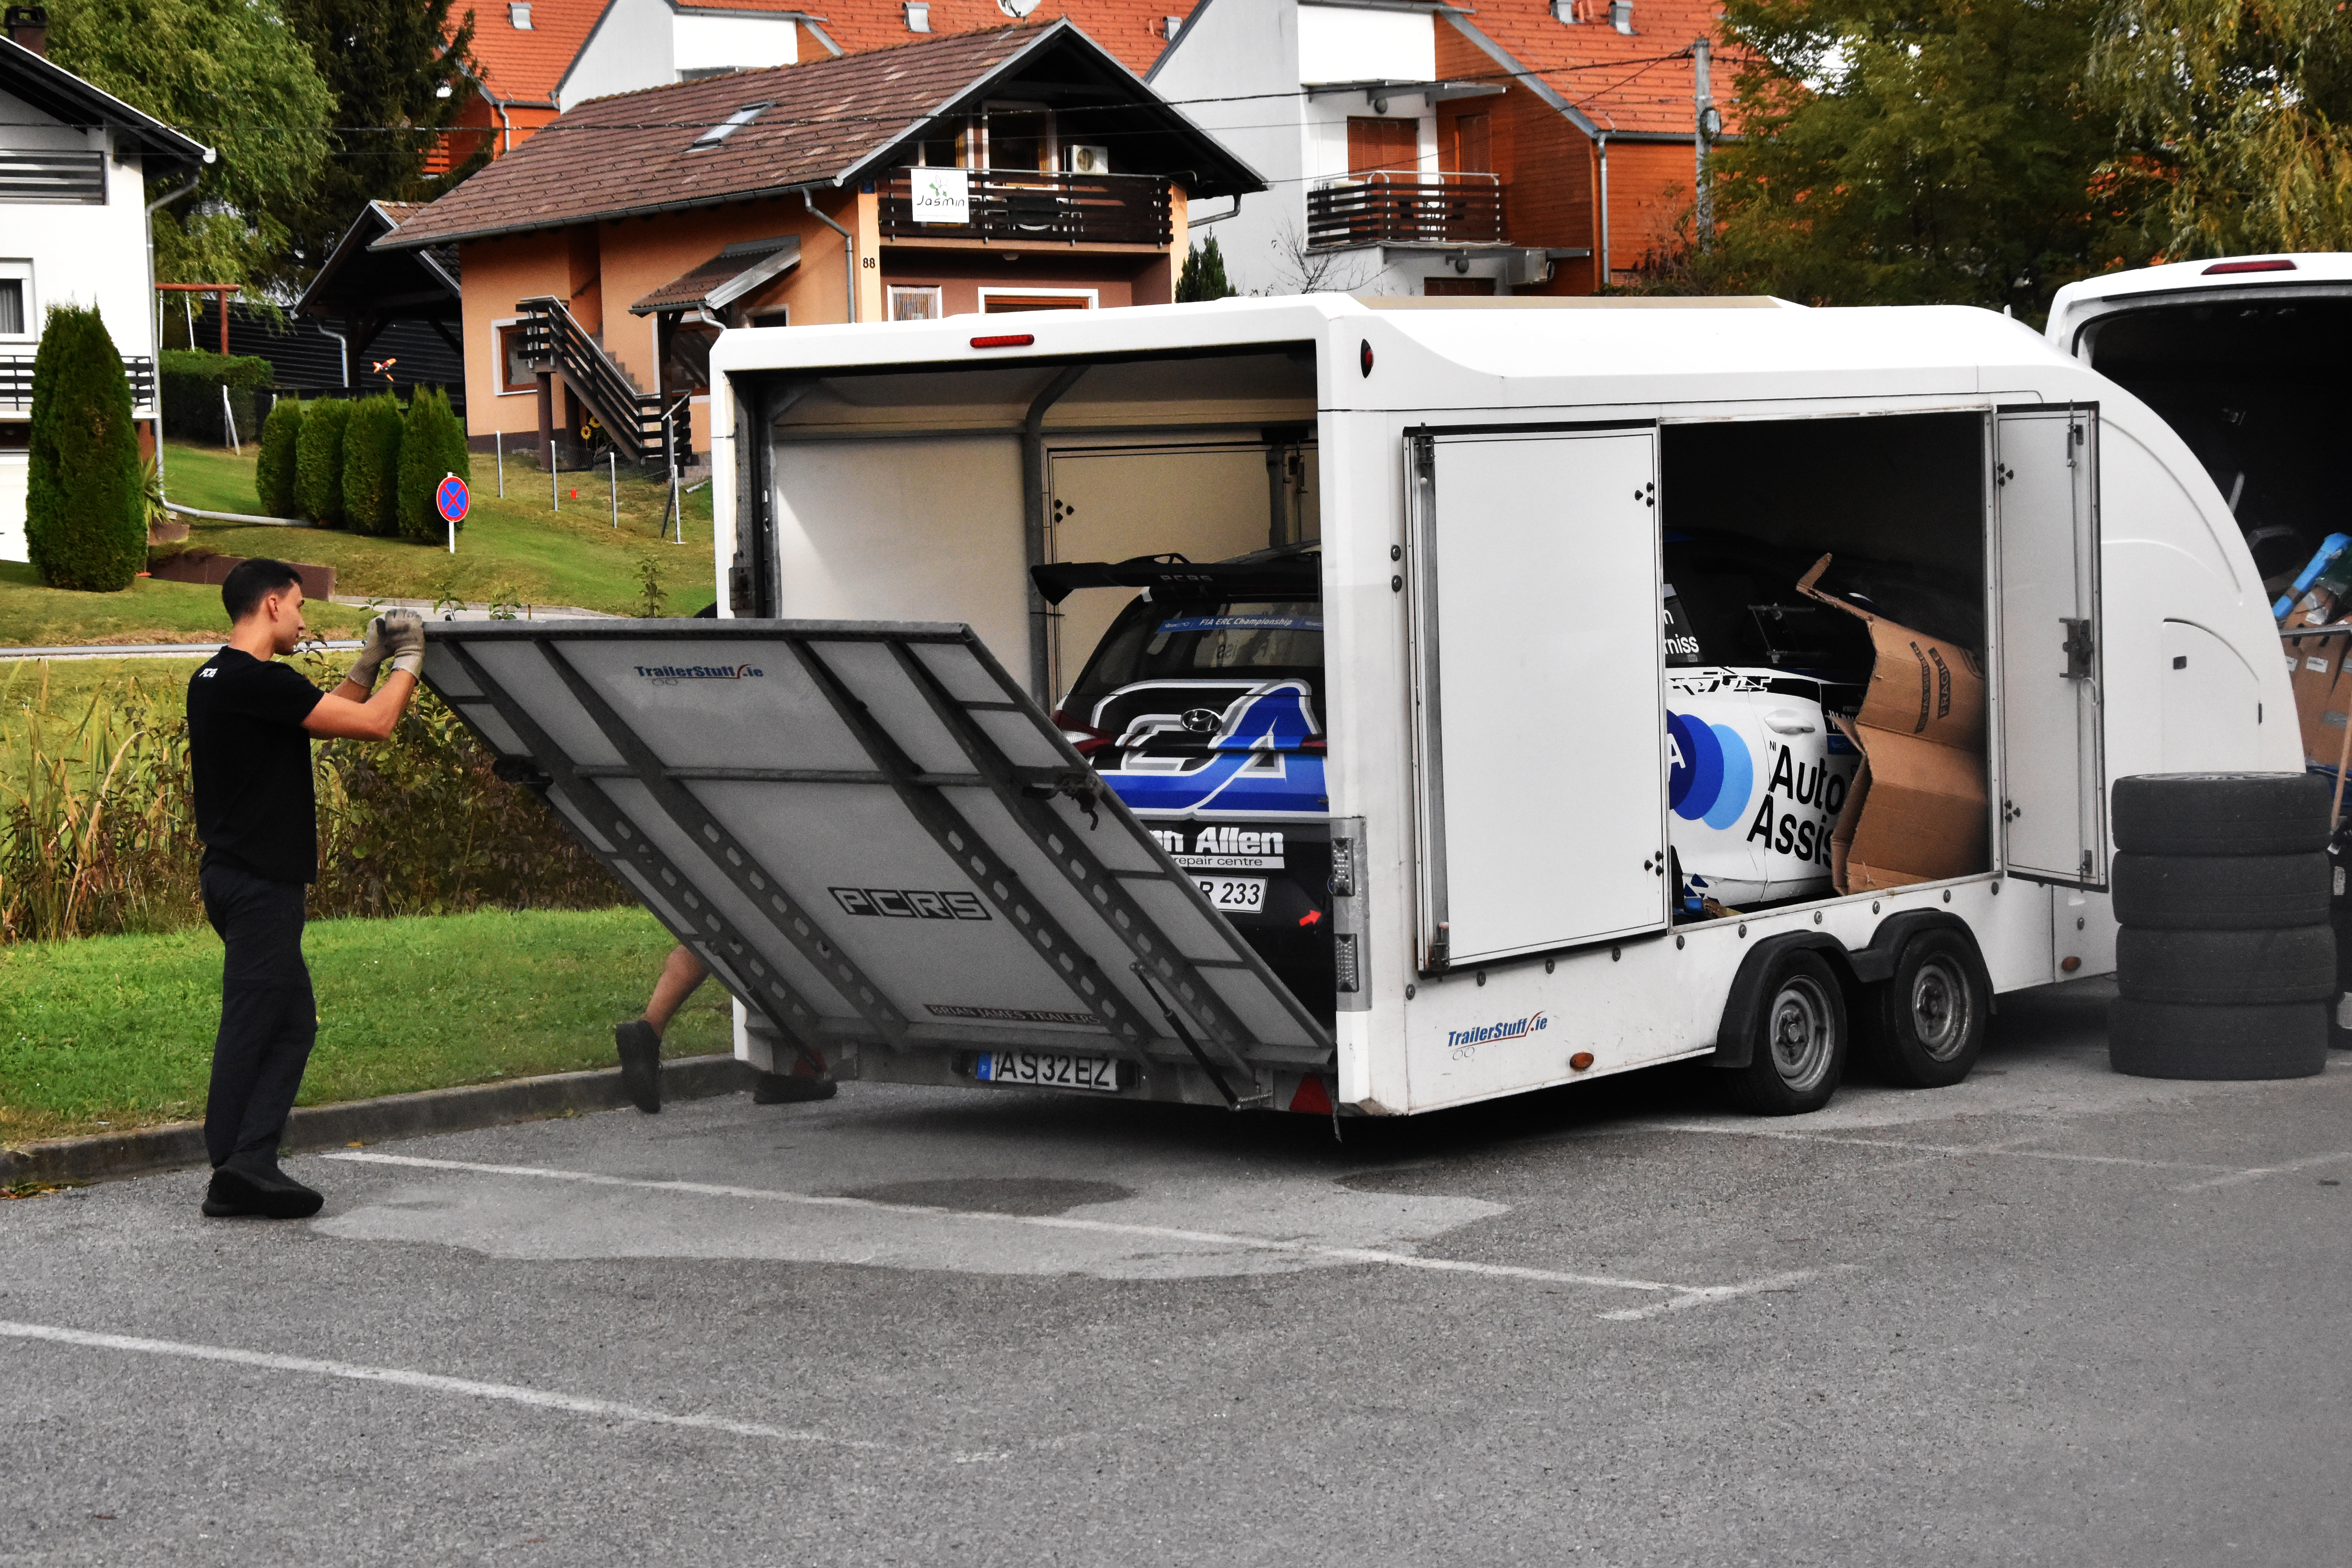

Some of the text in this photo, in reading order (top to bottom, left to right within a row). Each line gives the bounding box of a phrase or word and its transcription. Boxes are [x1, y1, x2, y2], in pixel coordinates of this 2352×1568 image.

[917, 195, 964, 207] Jasmin
[863, 257, 876, 268] 88
[1234, 617, 1293, 626] Championship
[634, 665, 764, 677] TrailerStuff.ie
[1770, 740, 1776, 752] NI
[1768, 744, 1846, 815] Auto
[1195, 827, 1283, 854] Allen
[1217, 857, 1262, 866] centre
[1220, 882, 1260, 905] 233
[833, 889, 987, 919] PCRS
[929, 1006, 1101, 1024] BRIAN JAMES TRAILERS
[1448, 1016, 1548, 1047] TrailerStuff.ie
